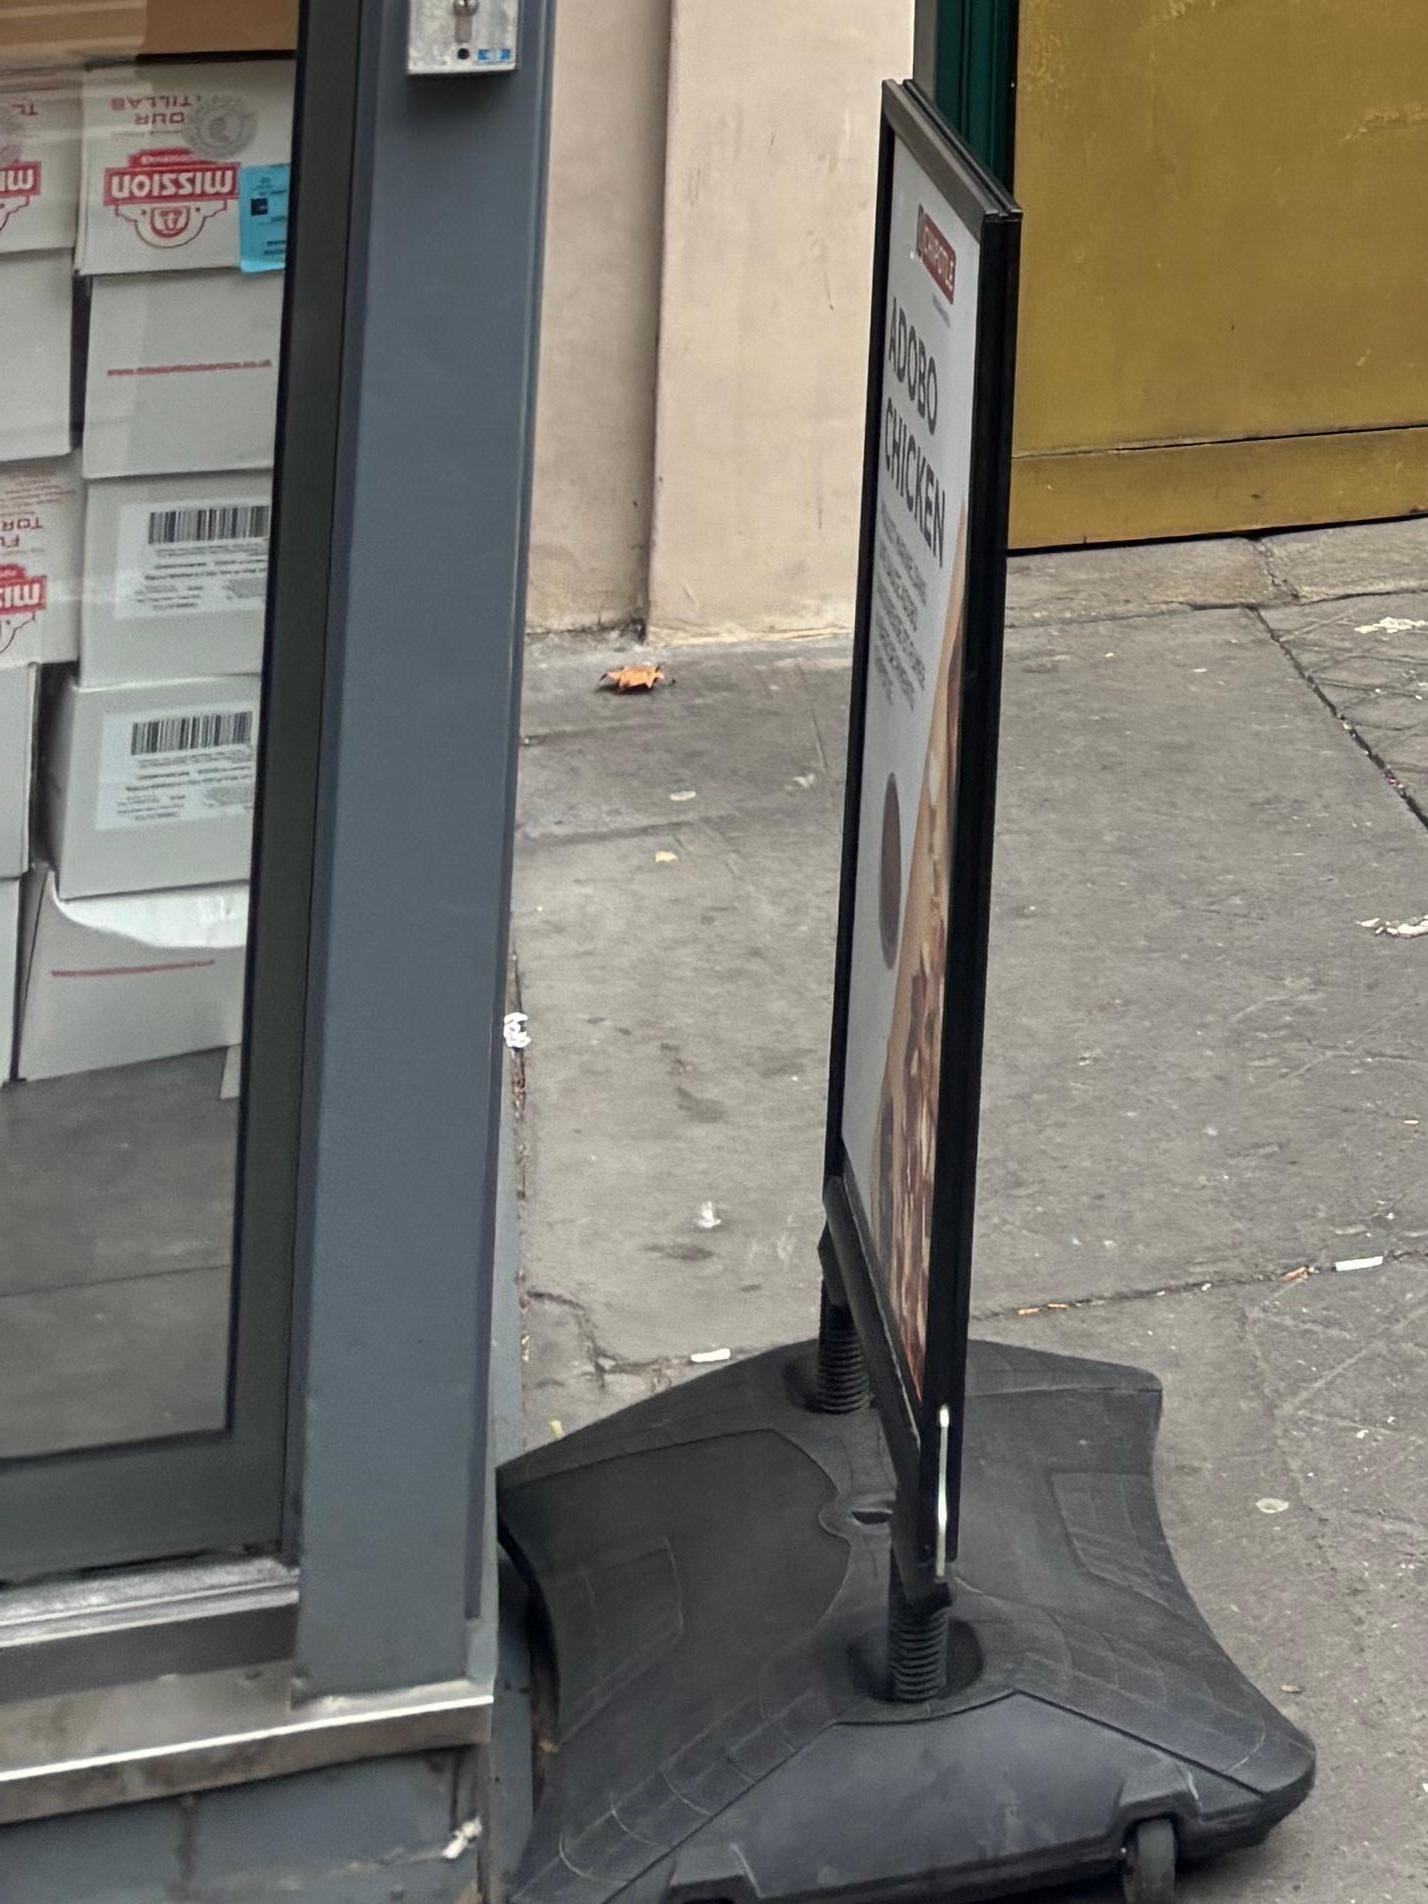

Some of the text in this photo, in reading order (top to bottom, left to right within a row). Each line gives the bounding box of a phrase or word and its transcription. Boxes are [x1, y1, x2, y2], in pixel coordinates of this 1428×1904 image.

[110, 170, 235, 200] MISSION
[889, 296, 938, 436] ADOBO
[885, 397, 946, 569] CHICKEN
